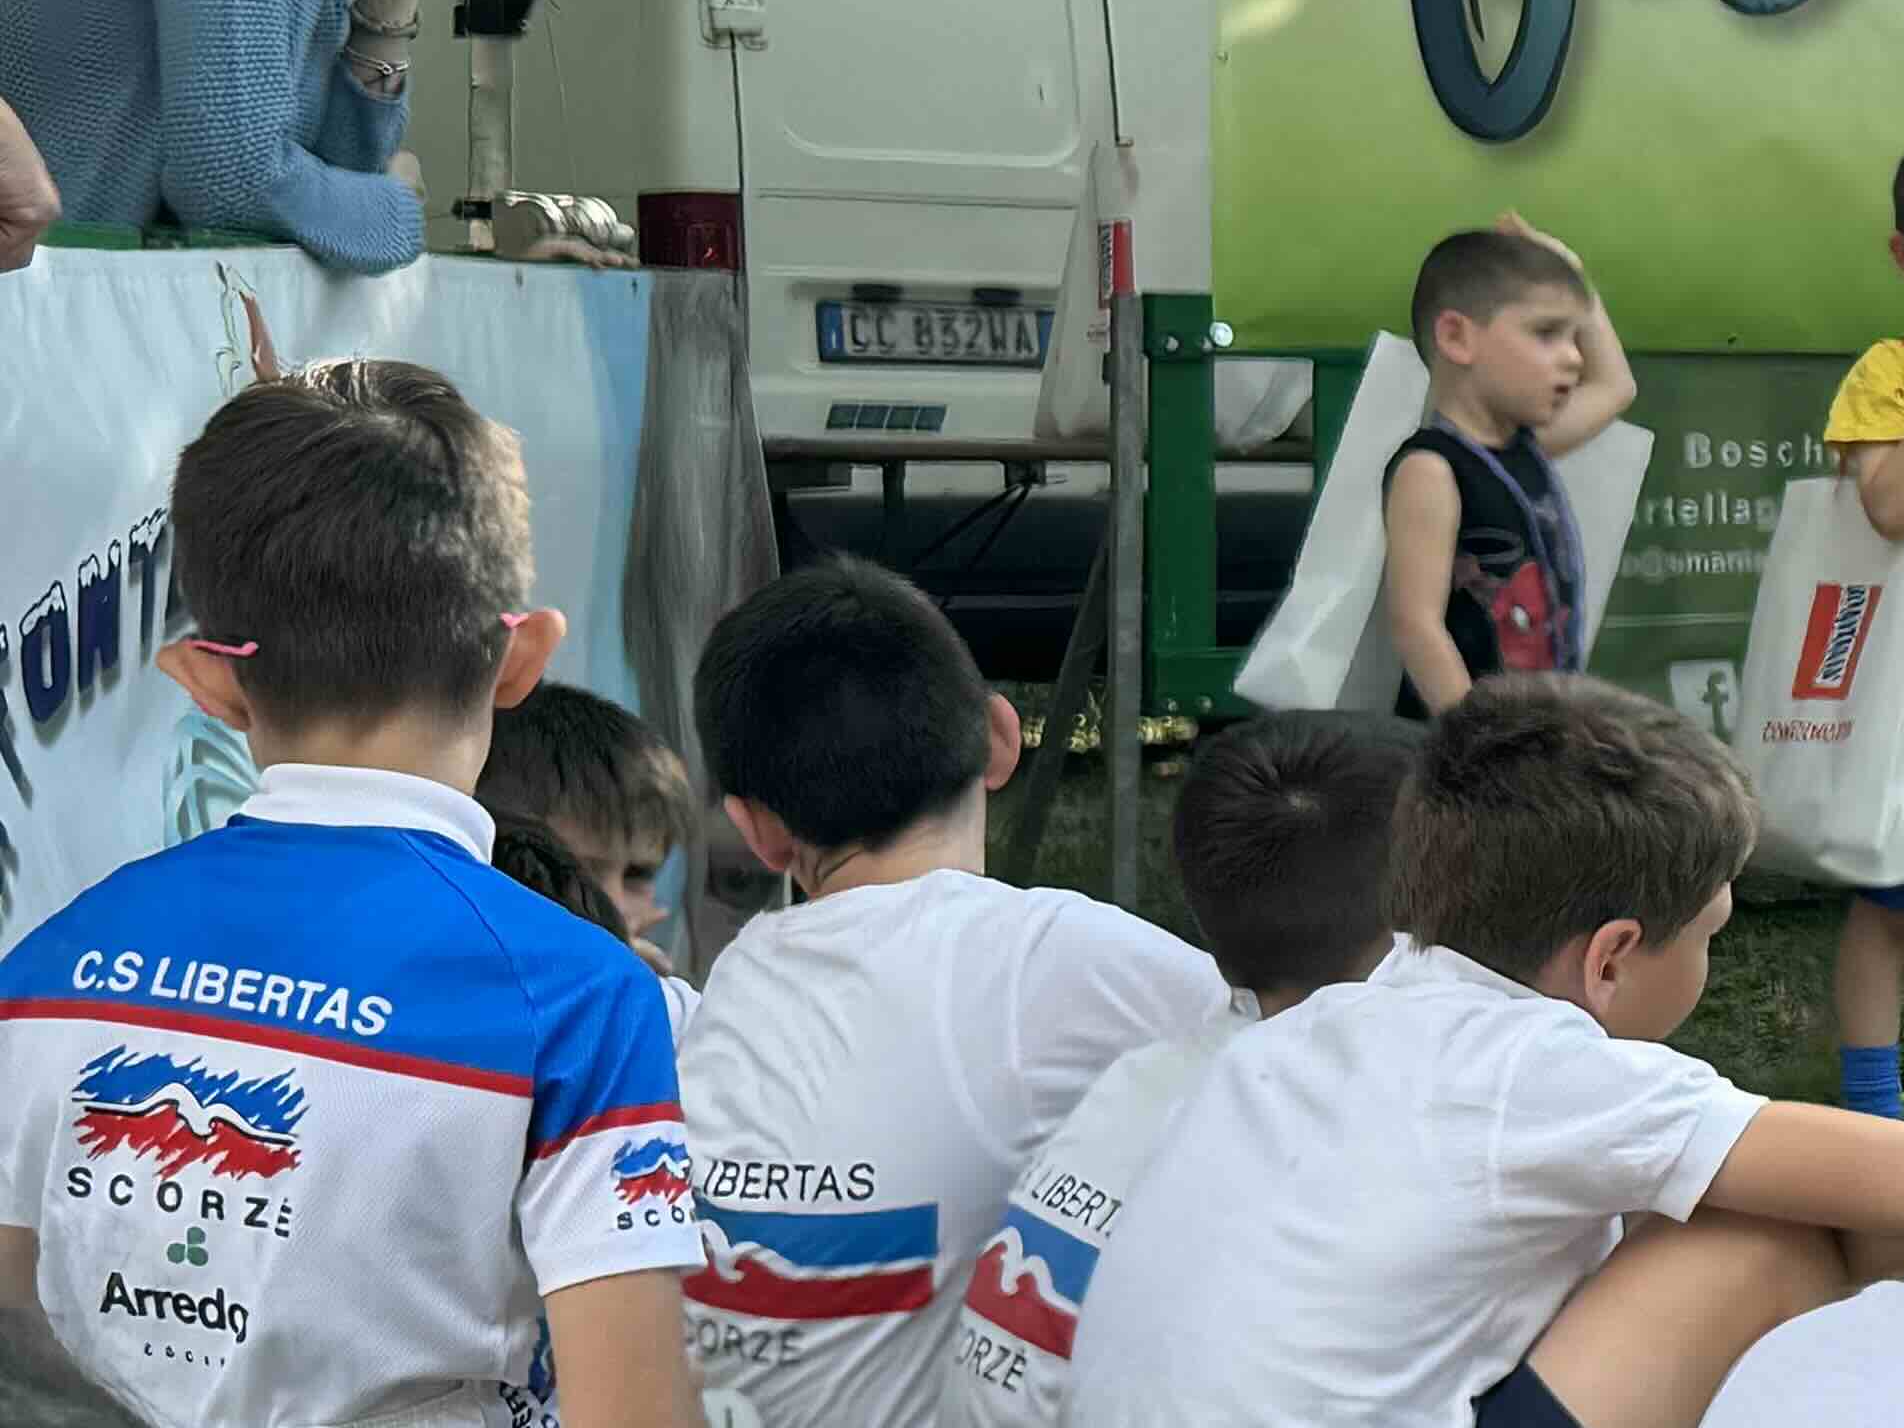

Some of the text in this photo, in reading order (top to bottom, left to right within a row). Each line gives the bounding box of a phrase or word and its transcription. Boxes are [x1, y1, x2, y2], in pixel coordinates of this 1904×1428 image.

[71, 950, 393, 1036] C.S LIBERTAS
[702, 1159, 876, 1203] IBERTAS
[1031, 1168, 1124, 1240] LIBERT
